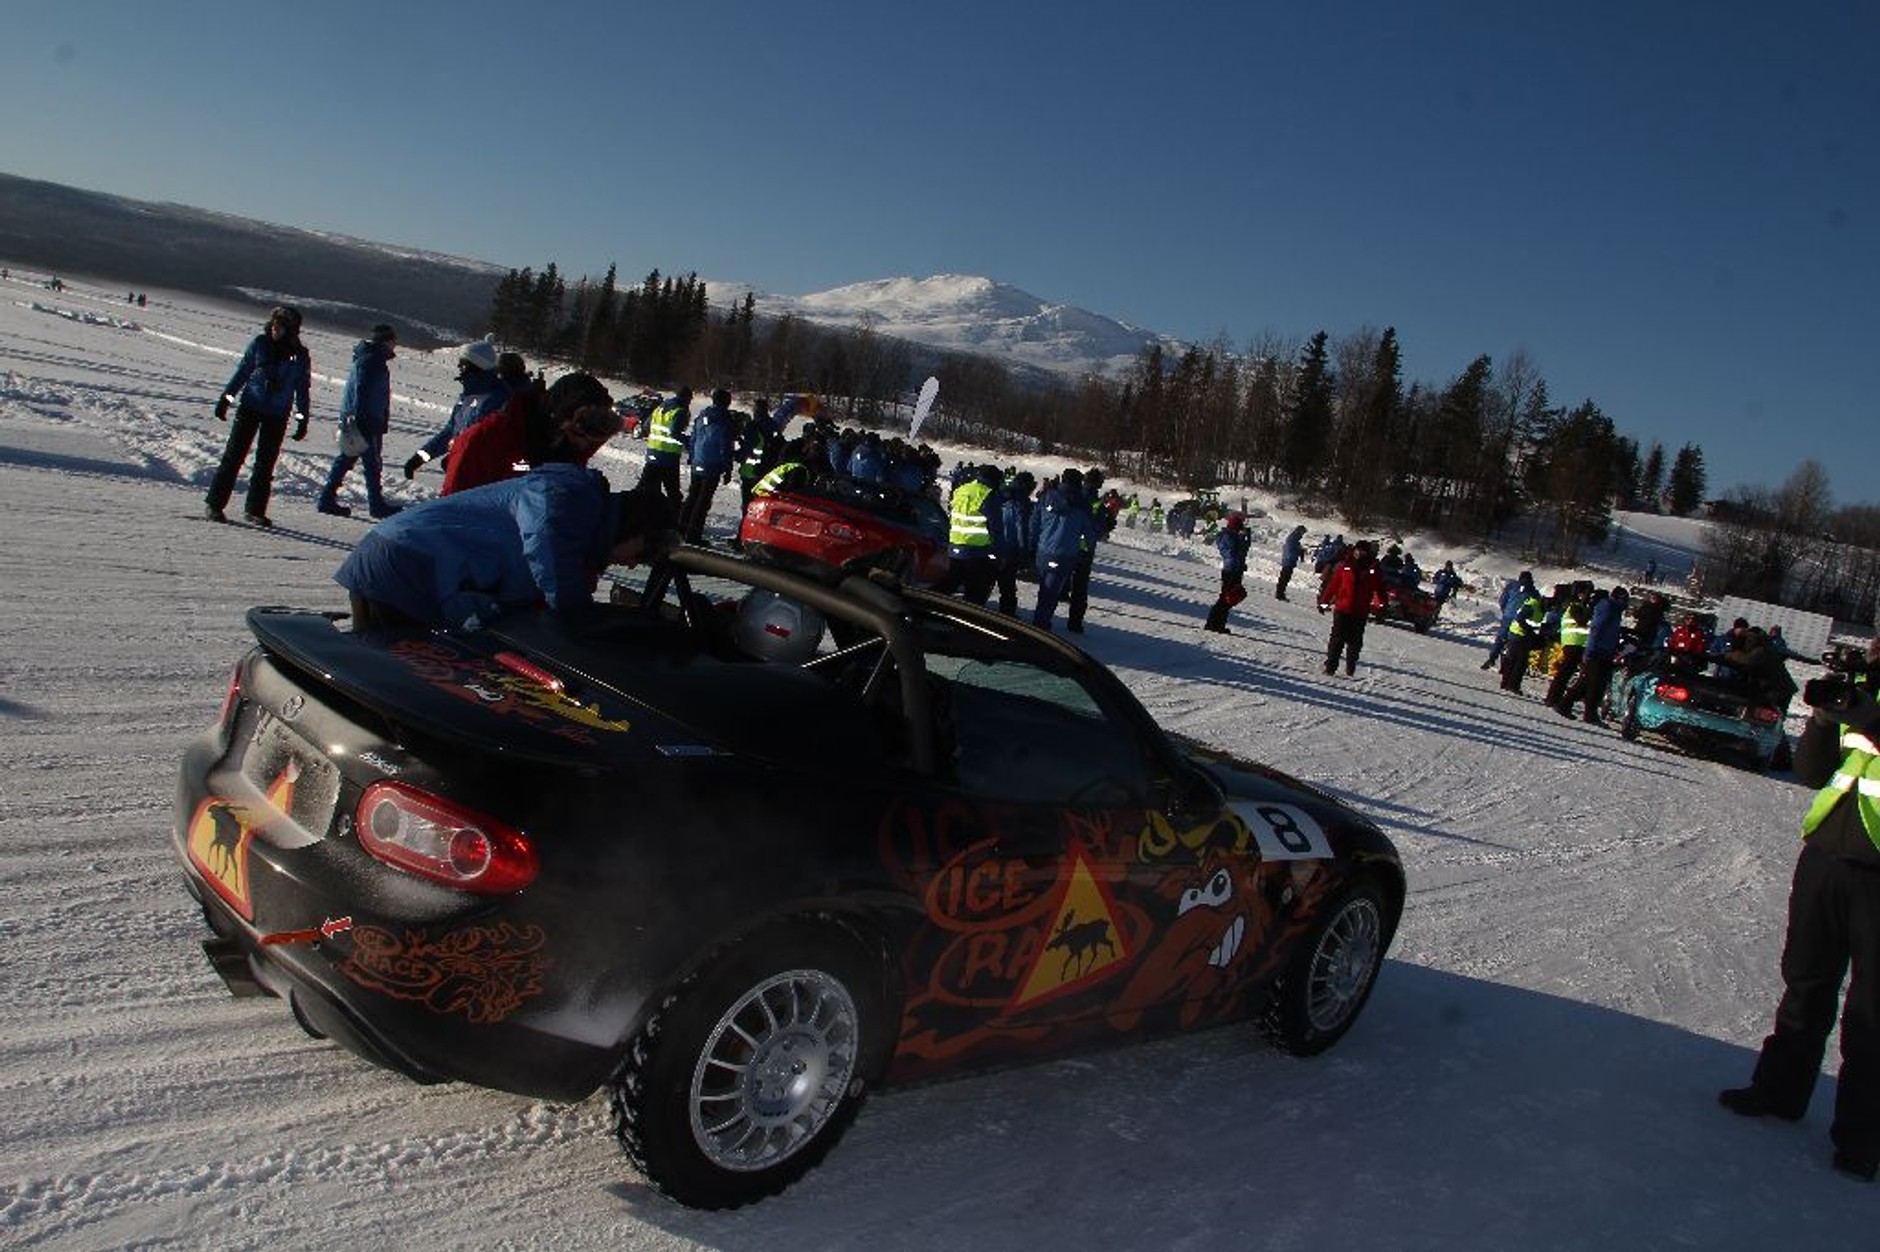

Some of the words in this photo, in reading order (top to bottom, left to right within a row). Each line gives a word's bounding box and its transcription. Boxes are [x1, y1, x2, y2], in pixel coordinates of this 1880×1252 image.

[1256, 808, 1312, 853] 8
[948, 858, 1034, 917] ICE
[363, 951, 424, 980] RACE
[957, 927, 1041, 989] RA
